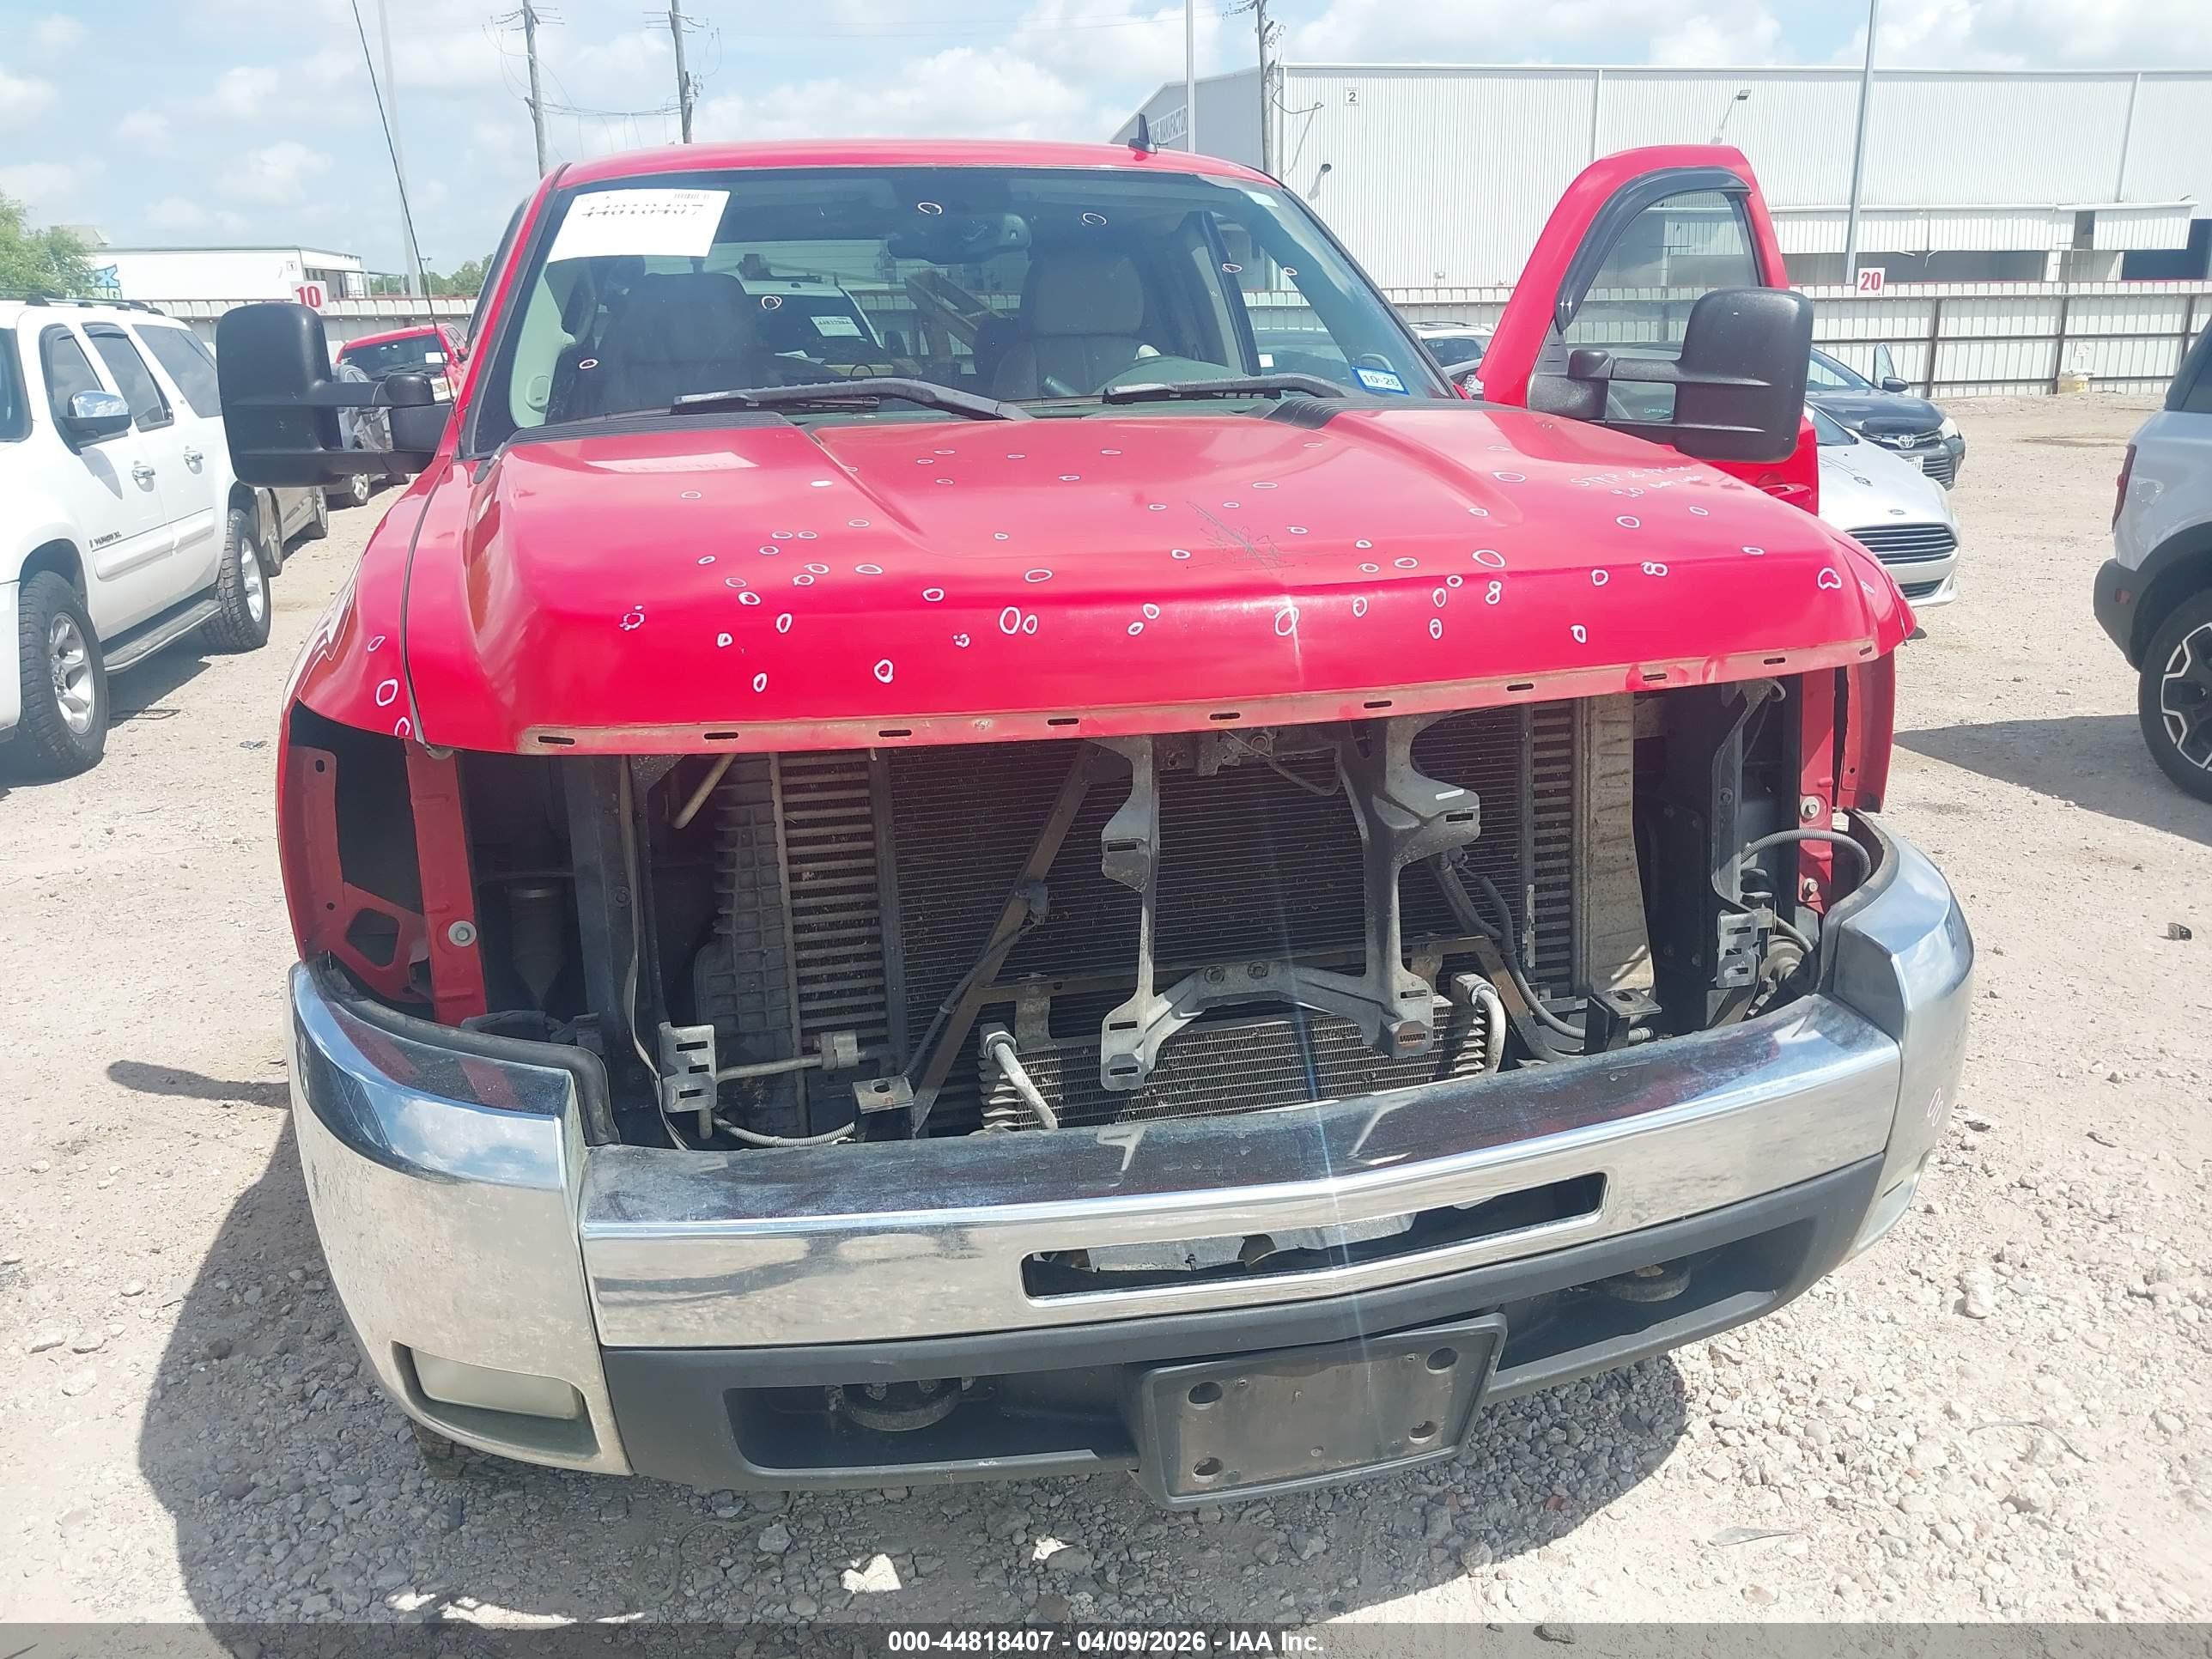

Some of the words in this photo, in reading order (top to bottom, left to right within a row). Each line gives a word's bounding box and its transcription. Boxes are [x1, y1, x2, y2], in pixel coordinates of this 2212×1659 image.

[1349, 92, 1357, 102] 2
[1860, 272, 1881, 290] 20
[295, 286, 321, 307] 10
